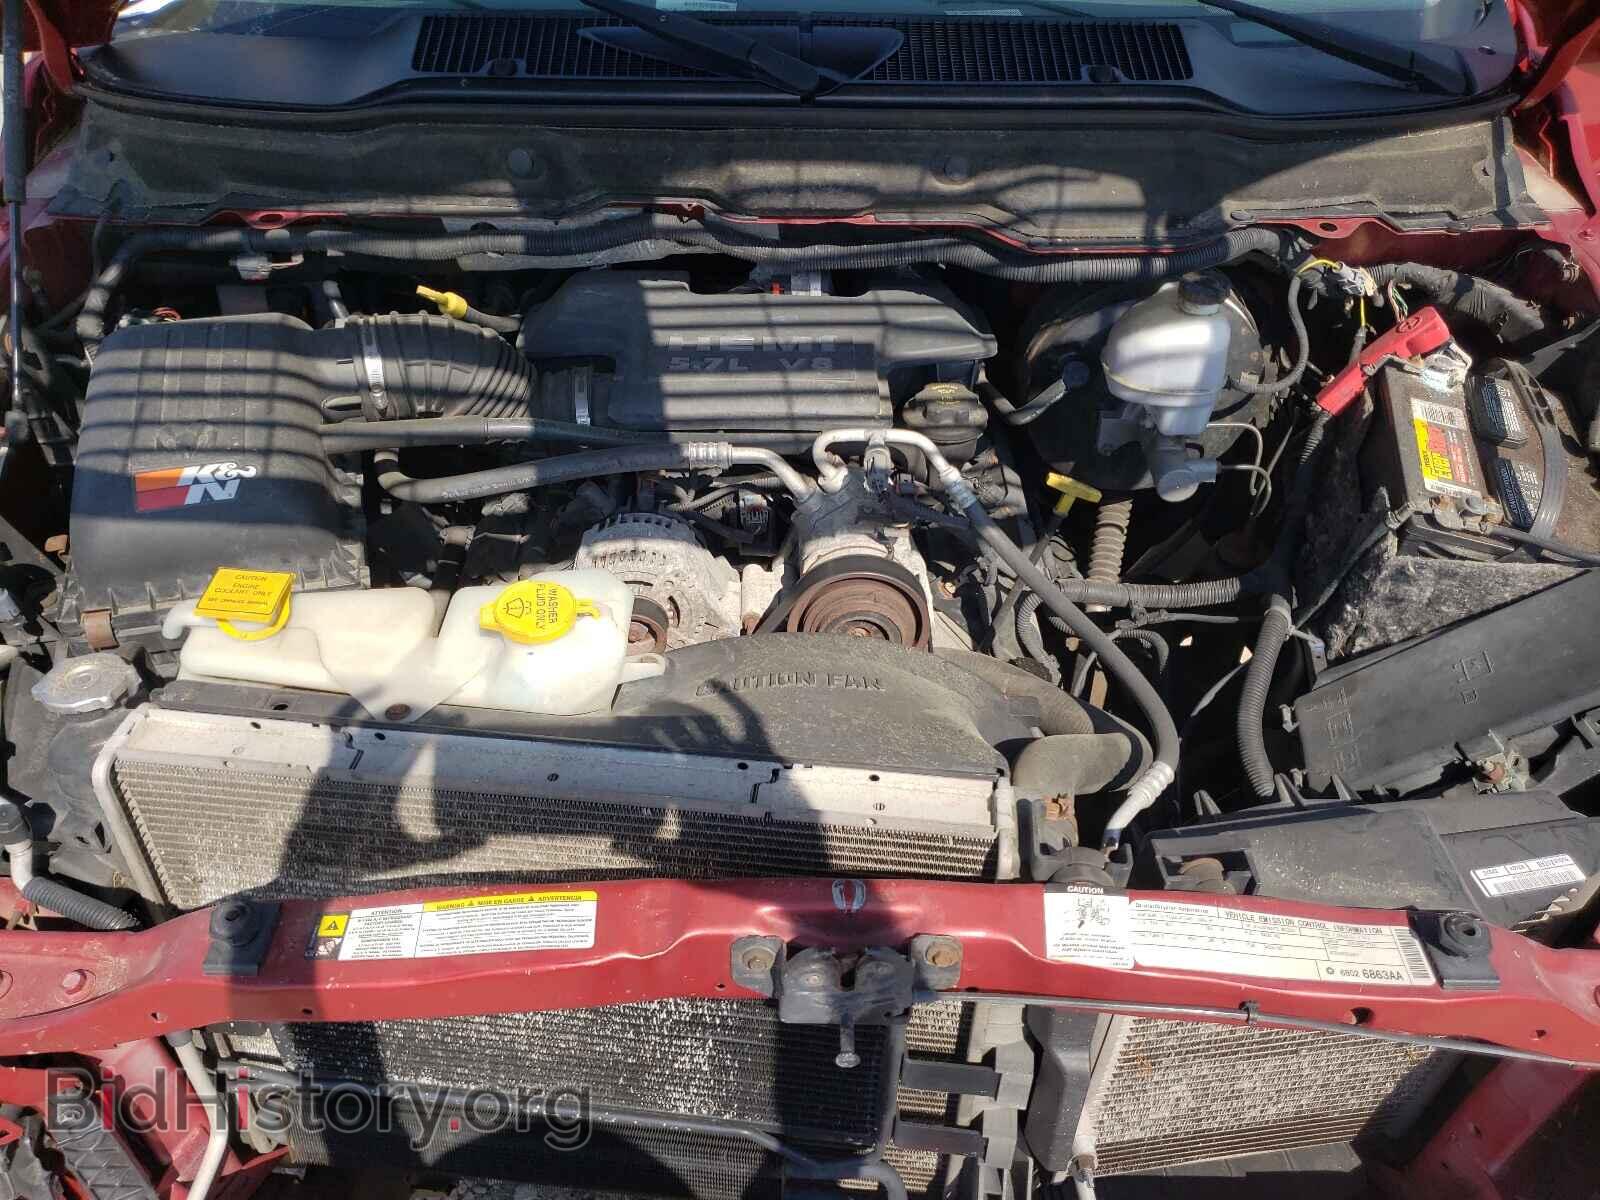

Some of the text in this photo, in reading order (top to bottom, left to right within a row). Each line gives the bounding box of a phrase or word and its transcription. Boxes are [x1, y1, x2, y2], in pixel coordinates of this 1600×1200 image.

[667, 356, 832, 370] 5.7L V8
[234, 574, 267, 582] CAUTION
[232, 582, 260, 590] ENGINE
[535, 583, 546, 630] FLUID ONLY
[548, 588, 559, 624] WASHER
[1067, 885, 1104, 895] CAUTION
[436, 902, 465, 911] WARNING
[1225, 911, 1255, 922] VEHICLE
[1258, 915, 1295, 927] EMISSION
[1298, 919, 1327, 930] CONTROL
[1333, 924, 1383, 935] INFORMATION
[1362, 968, 1405, 981] 6863AA
